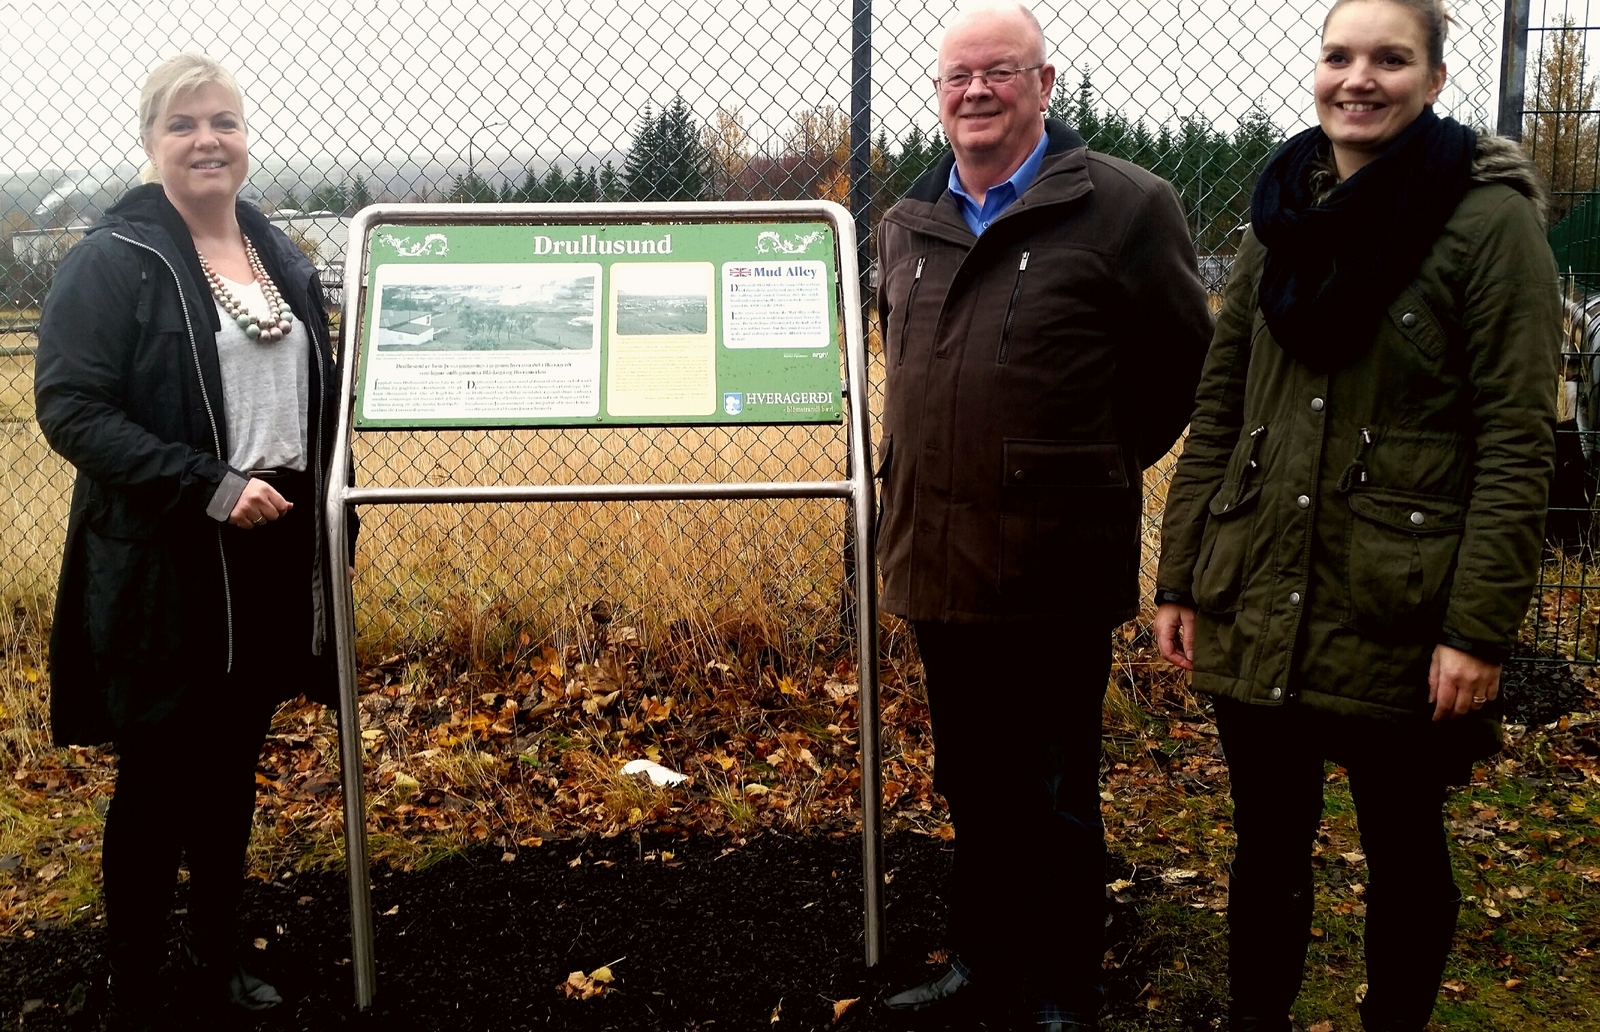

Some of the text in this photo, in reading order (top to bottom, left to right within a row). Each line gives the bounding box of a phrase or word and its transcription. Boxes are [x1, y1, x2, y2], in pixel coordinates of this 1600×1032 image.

[533, 234, 673, 255] Drullusund
[754, 266, 817, 279] Mud Alley
[746, 392, 833, 405] HVERAGERÐI
